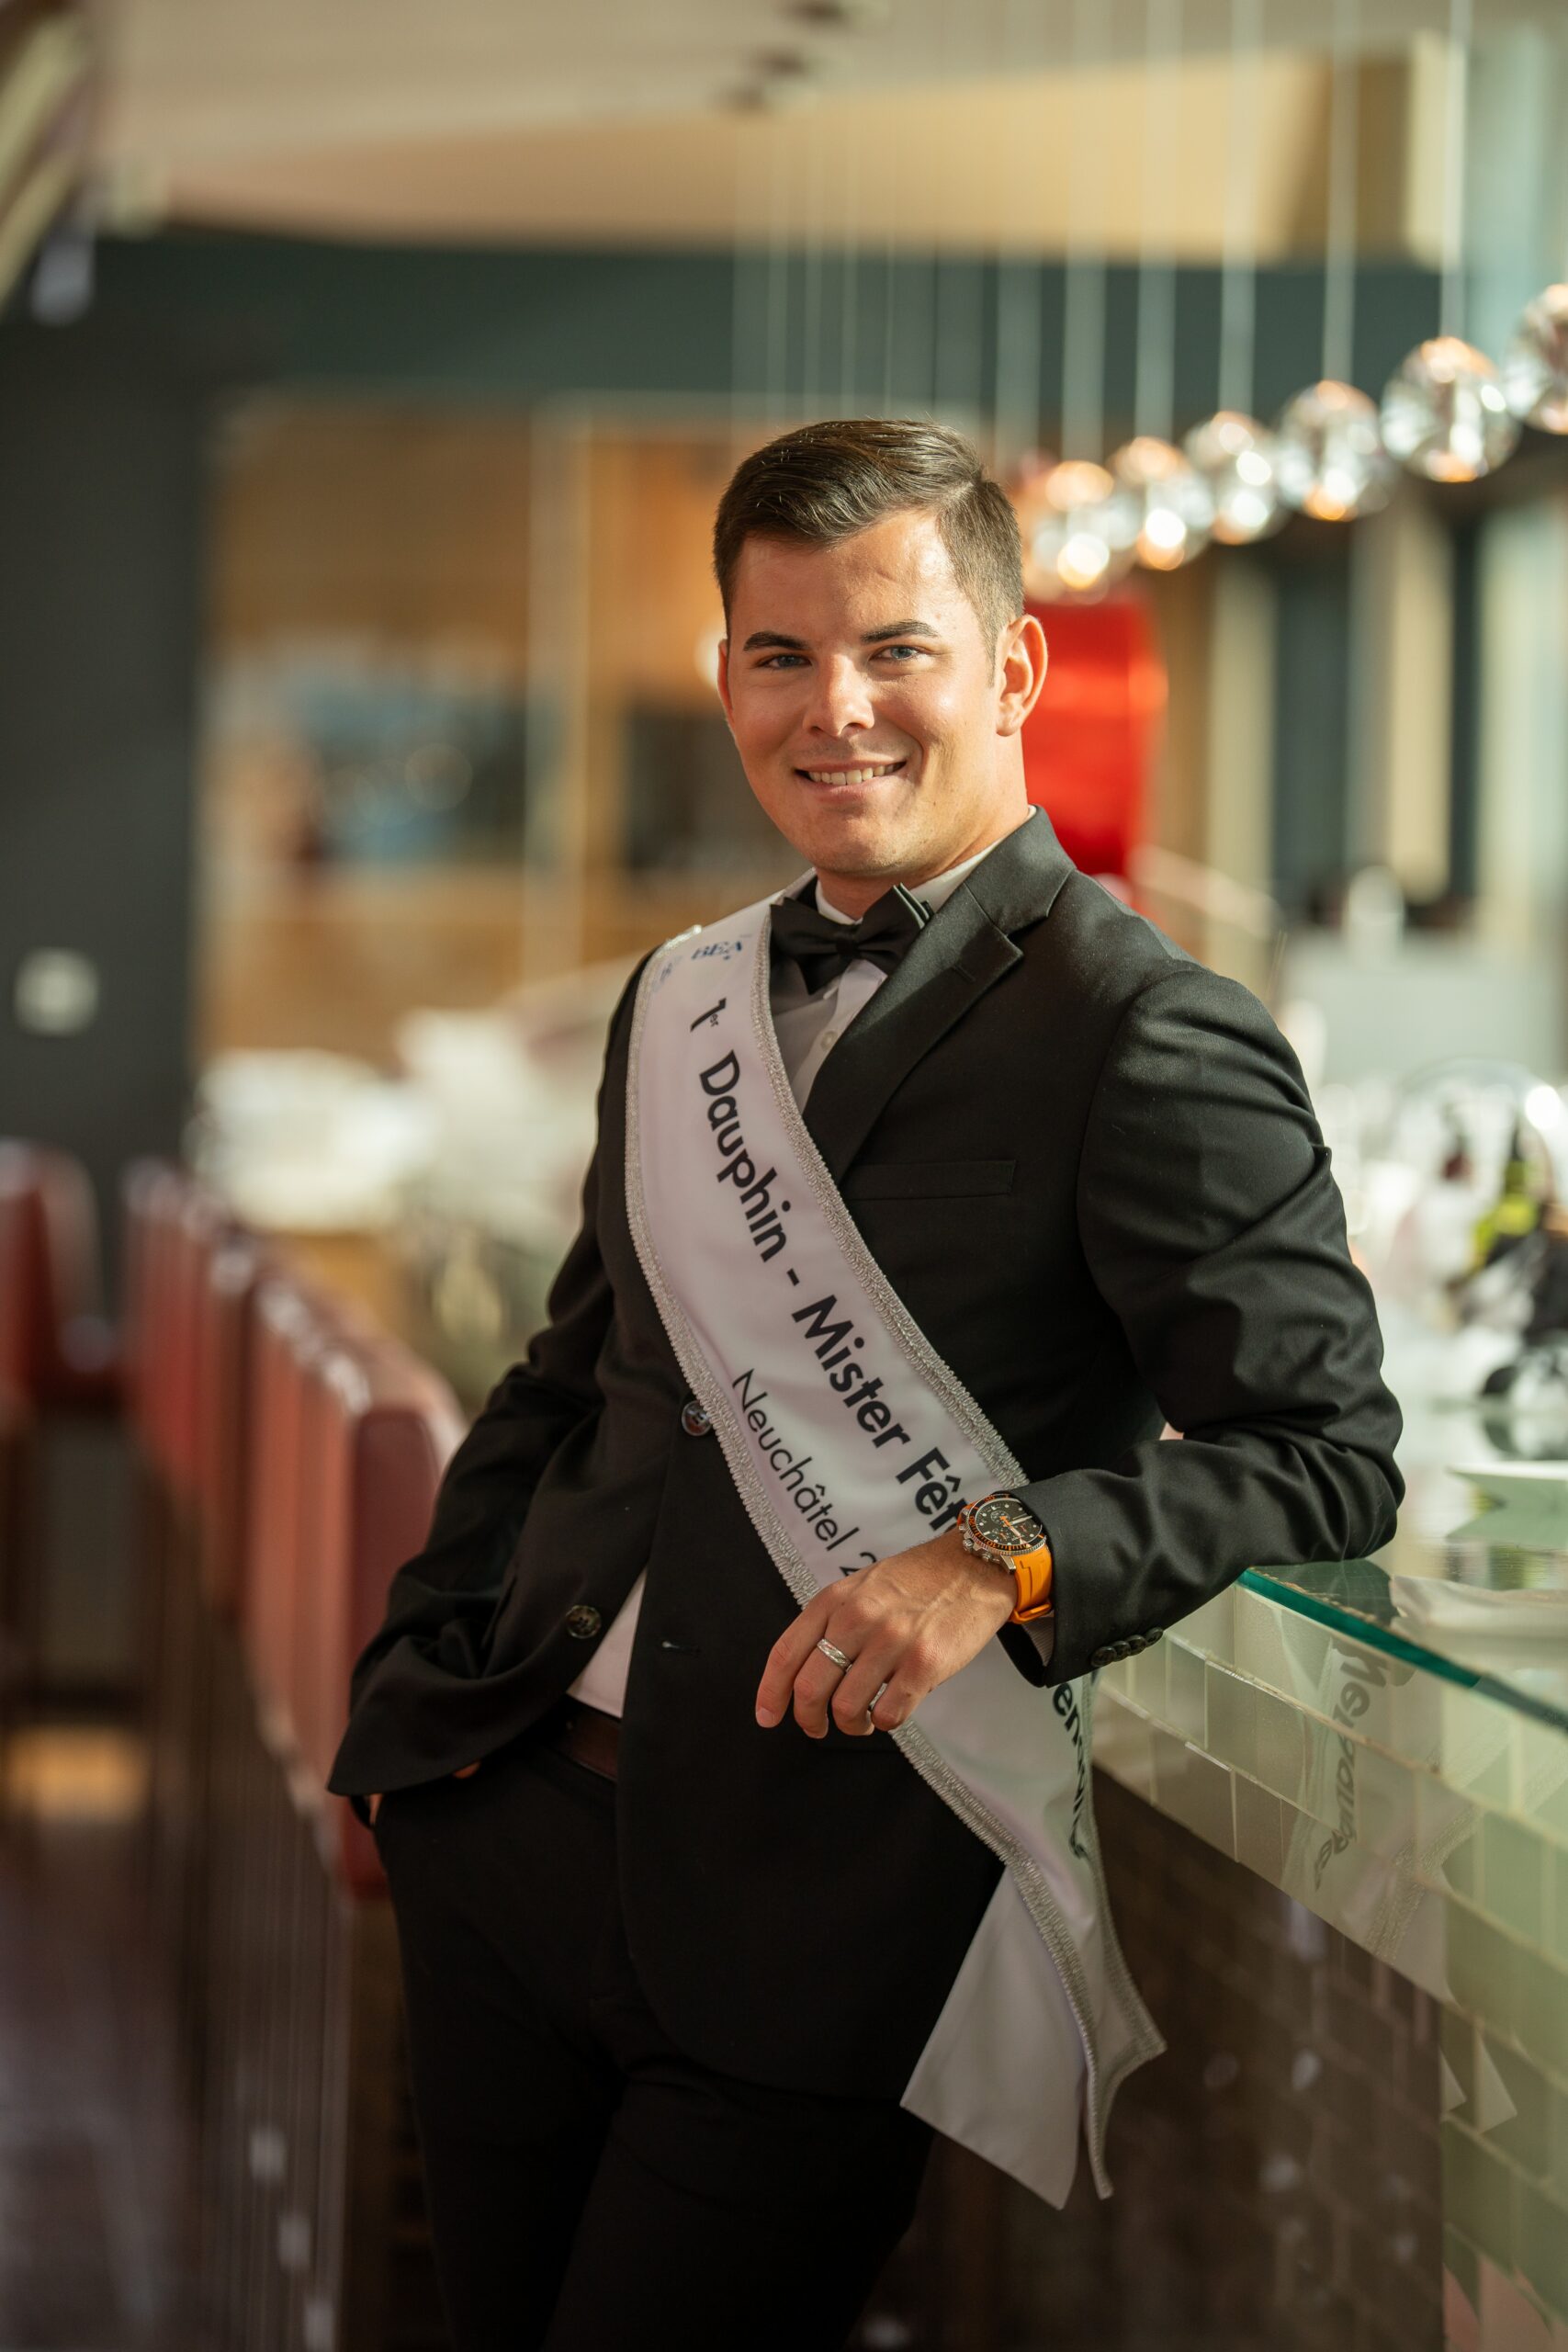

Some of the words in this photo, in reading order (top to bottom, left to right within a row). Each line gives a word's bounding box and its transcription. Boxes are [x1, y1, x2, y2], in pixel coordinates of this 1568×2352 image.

[699, 1049, 791, 1263] Dauphin
[792, 1295, 910, 1448] Mister
[895, 1447, 969, 1532] Fêt
[731, 1368, 860, 1552] Neuchâtel
